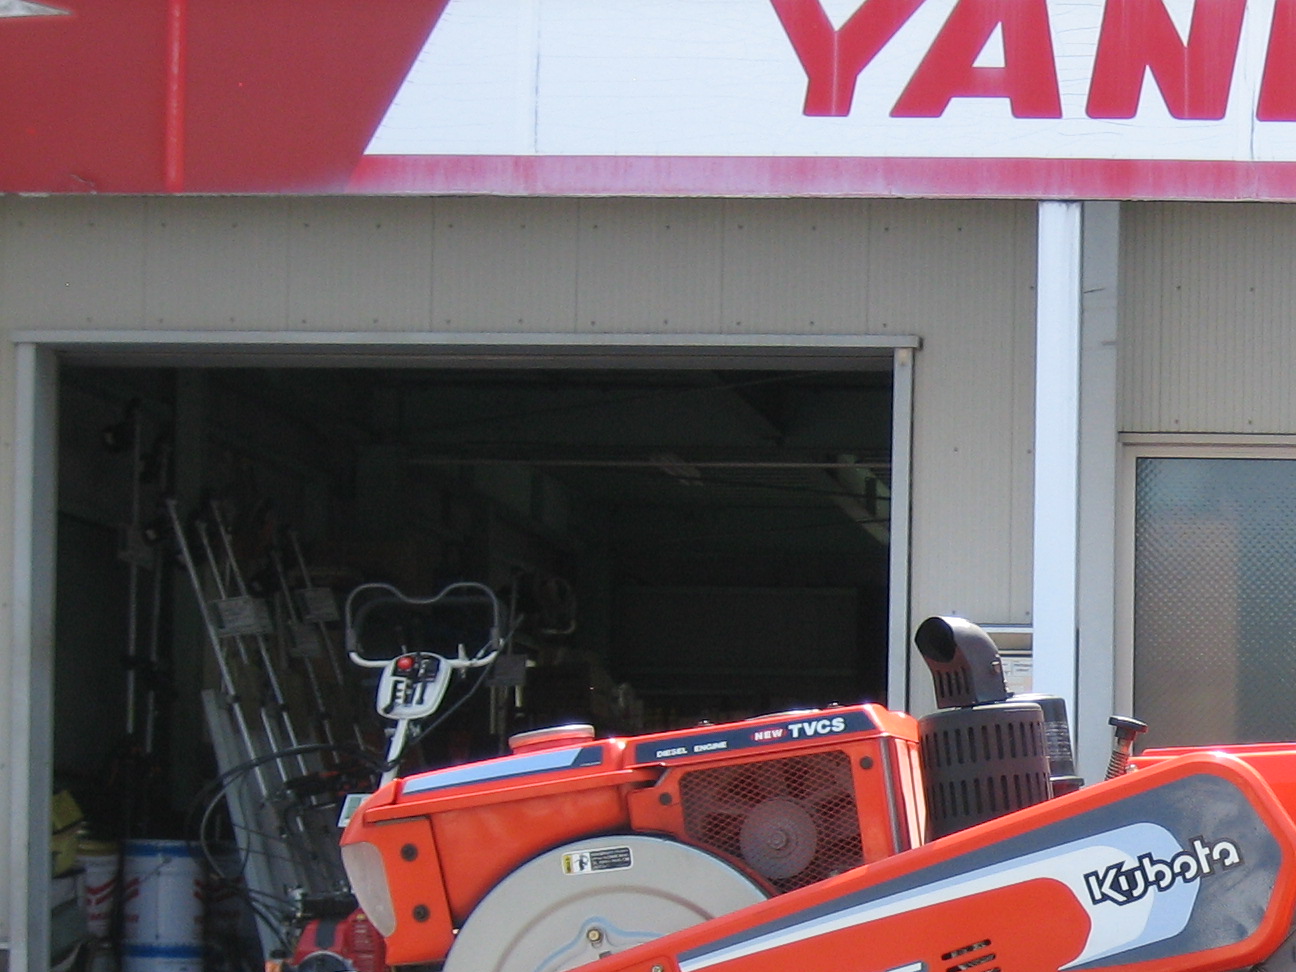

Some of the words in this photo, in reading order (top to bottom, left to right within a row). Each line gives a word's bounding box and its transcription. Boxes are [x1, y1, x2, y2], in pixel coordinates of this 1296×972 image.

[754, 728, 783, 741] NEW
[788, 717, 845, 738] TVCS
[656, 747, 687, 758] DIESEL
[693, 741, 728, 752] ENGINE
[1083, 836, 1241, 905] Kubota
